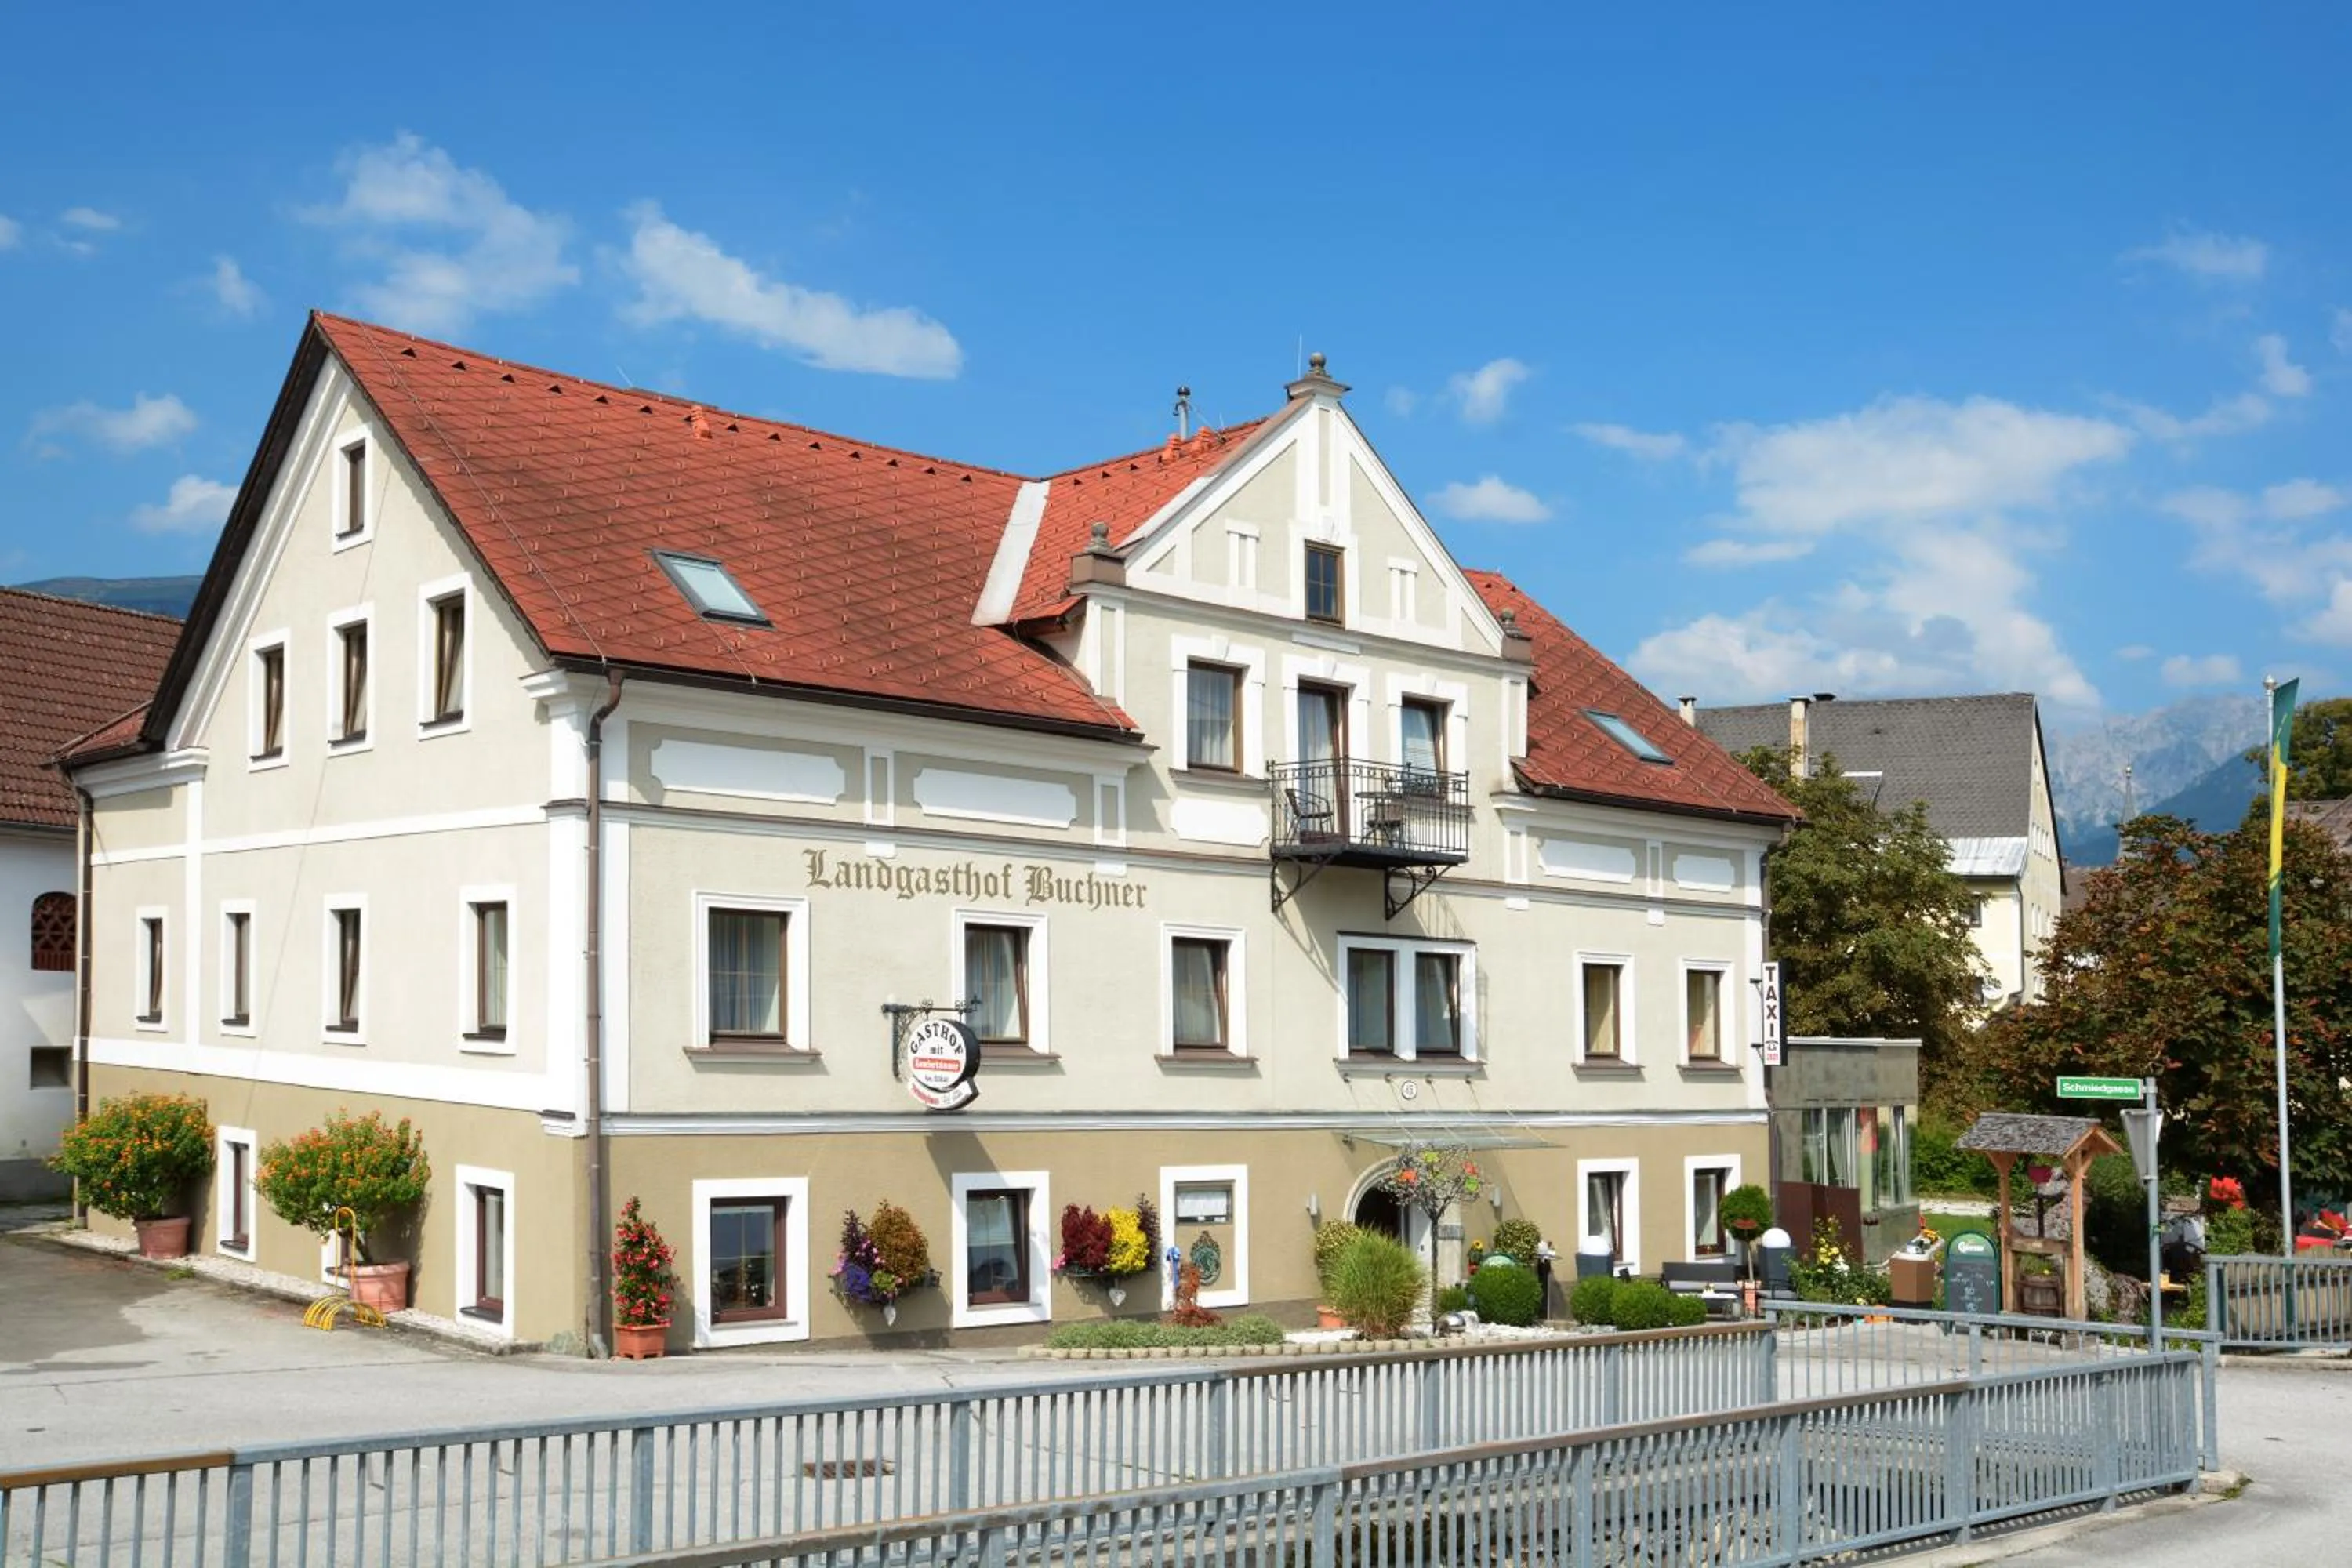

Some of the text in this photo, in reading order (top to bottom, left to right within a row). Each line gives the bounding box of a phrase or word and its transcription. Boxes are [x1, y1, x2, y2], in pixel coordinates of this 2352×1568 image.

[803, 849, 1148, 911] Landgasthof Buchner
[1765, 965, 1778, 1038] TAXI
[909, 1022, 964, 1054] GASTHOF
[930, 1044, 944, 1054] mit
